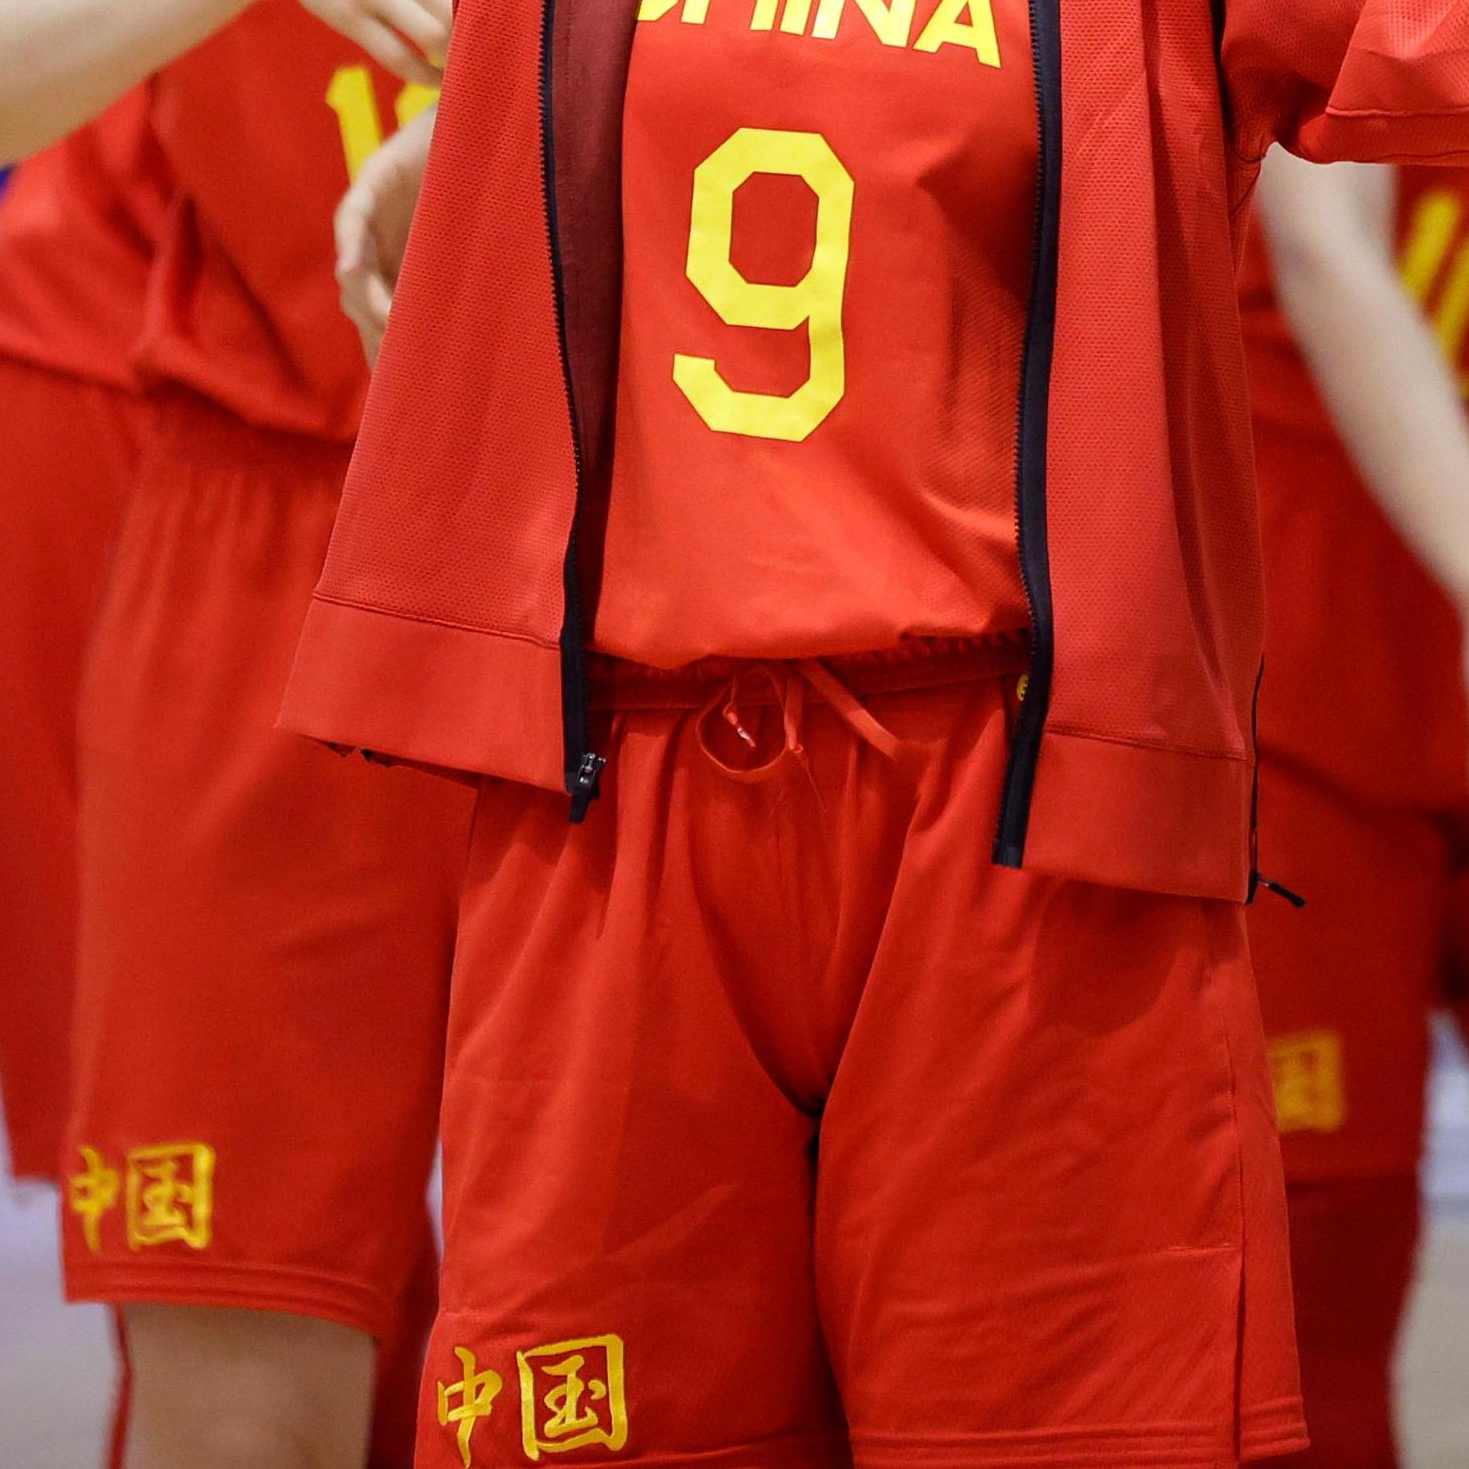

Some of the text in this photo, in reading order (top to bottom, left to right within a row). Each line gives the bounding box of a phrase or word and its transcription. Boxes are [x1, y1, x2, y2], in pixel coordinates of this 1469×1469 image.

[672, 126, 855, 442] 9
[70, 1140, 215, 1252] 中国
[436, 1333, 629, 1468] 中国
